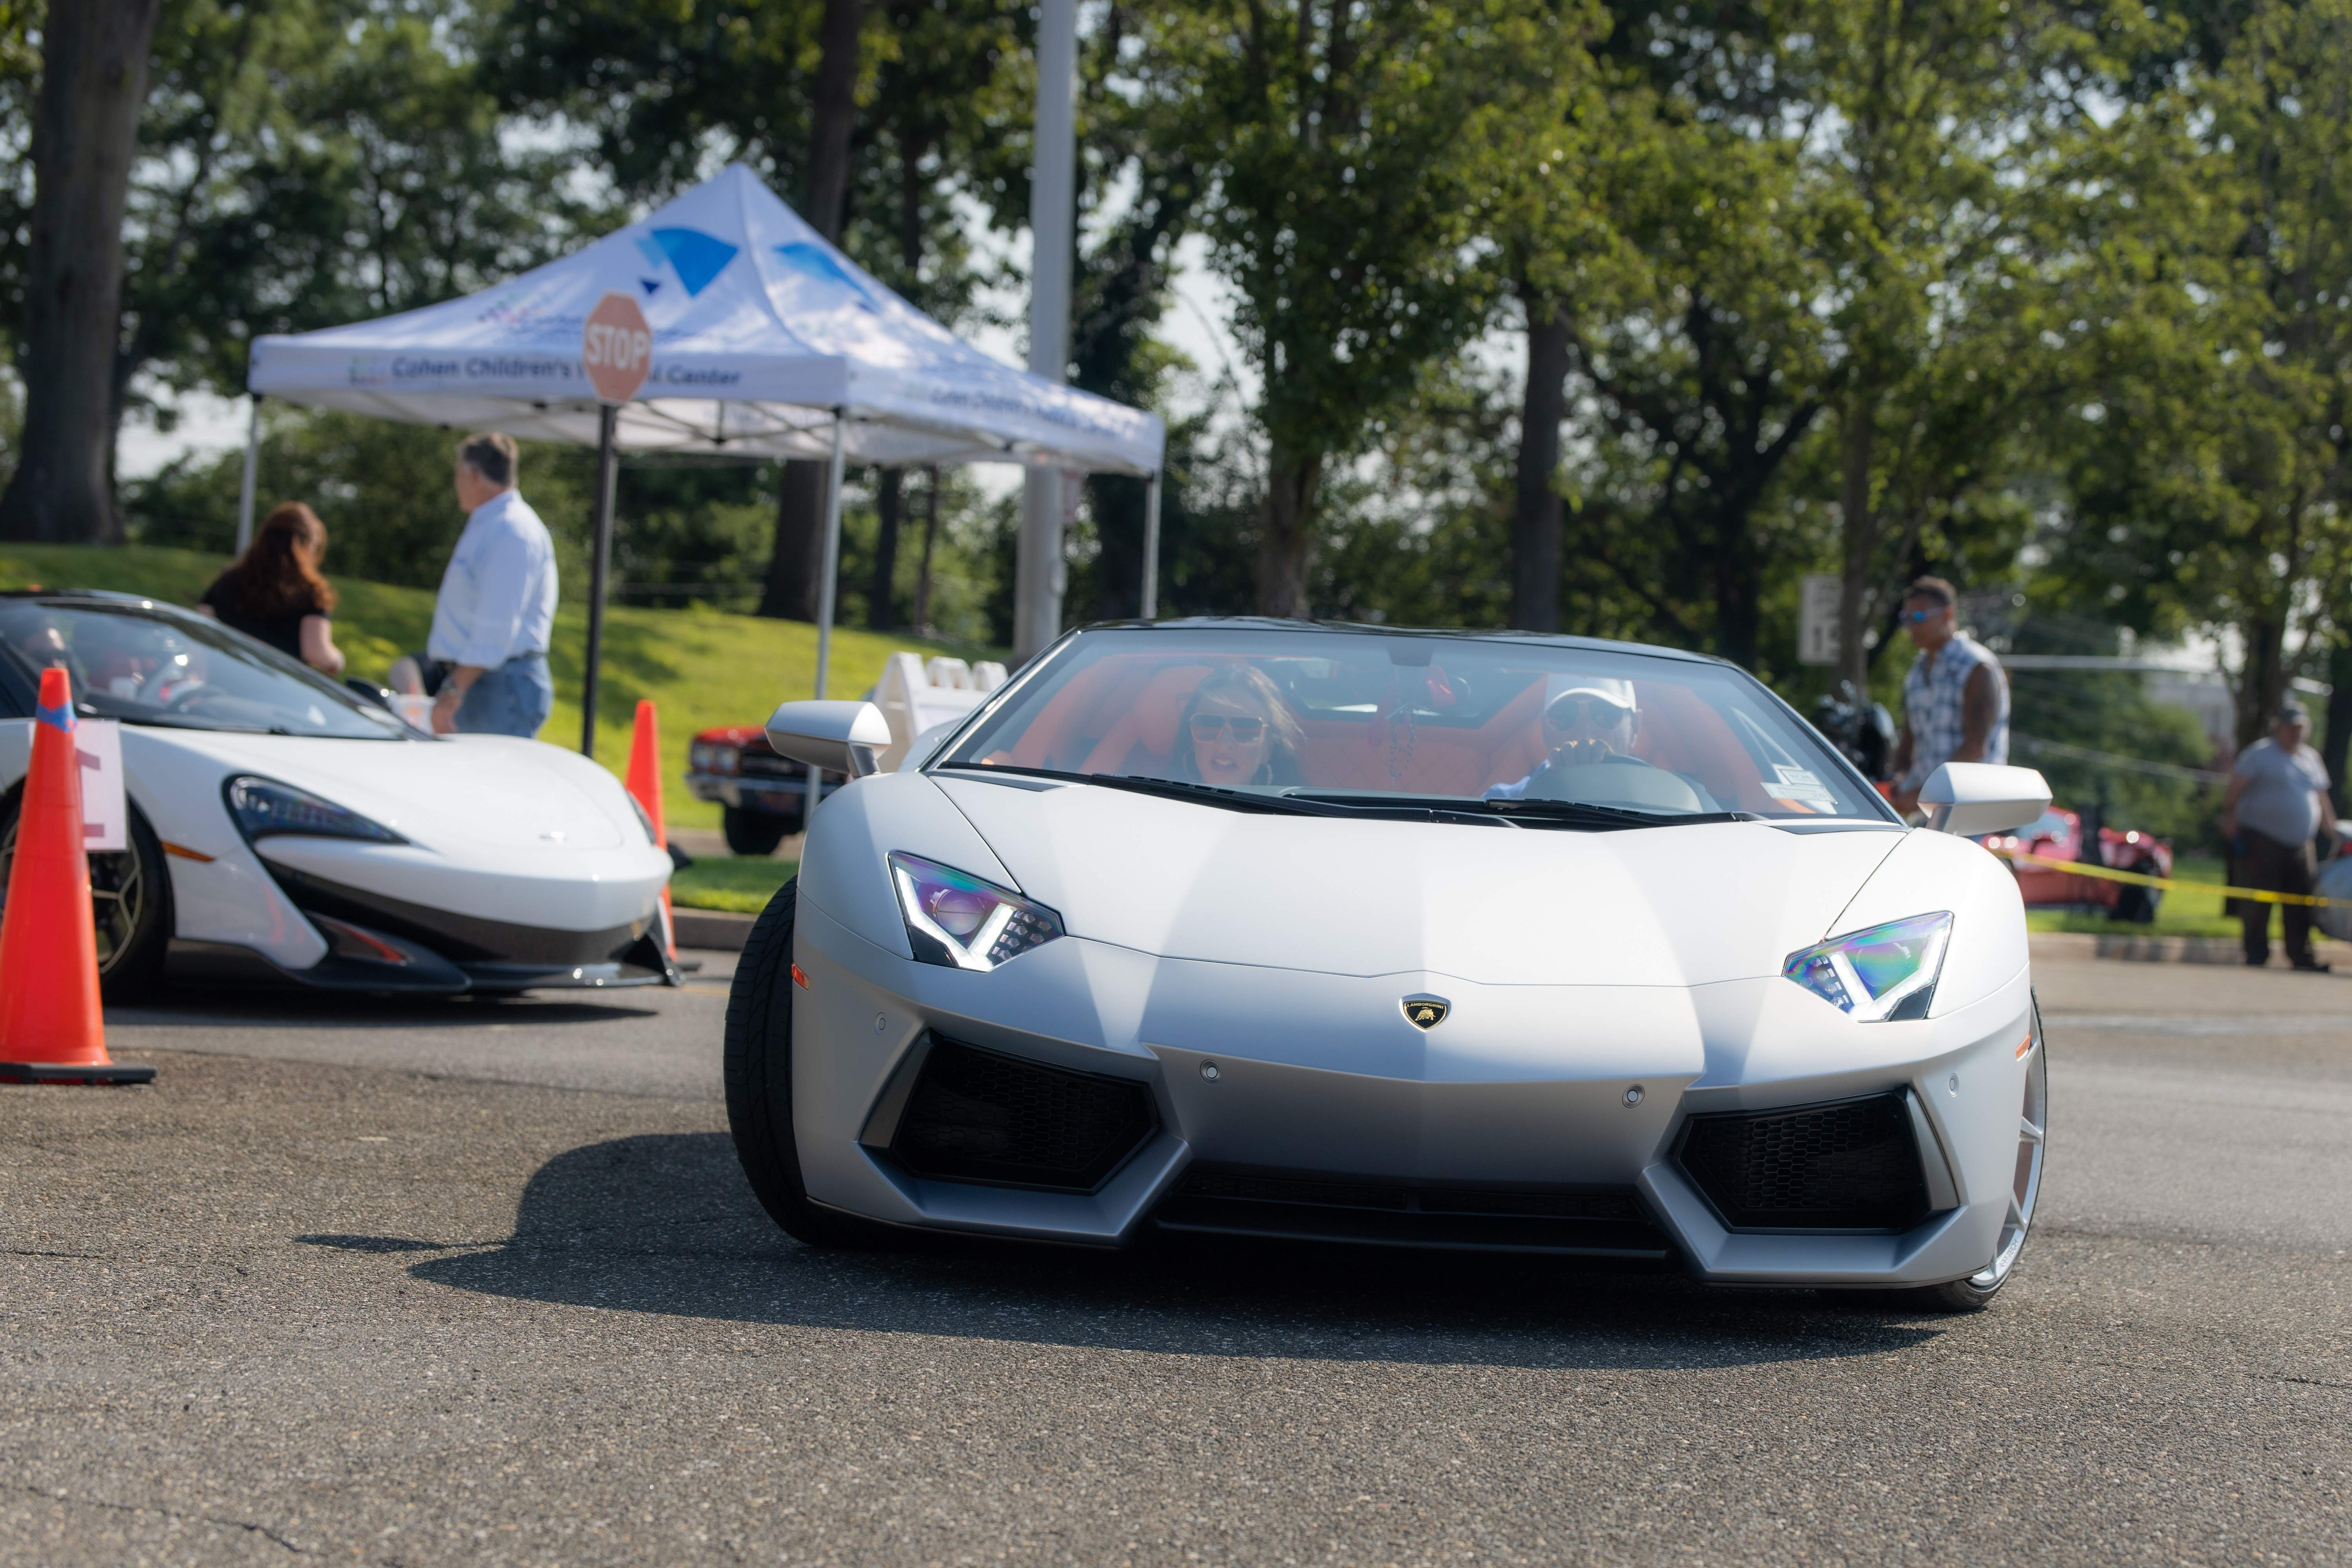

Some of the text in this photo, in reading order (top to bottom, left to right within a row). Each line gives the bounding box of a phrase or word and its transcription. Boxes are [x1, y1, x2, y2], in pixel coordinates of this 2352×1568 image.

[588, 322, 650, 371] STOP
[392, 355, 458, 379] Cohen
[466, 356, 570, 379] Children's
[667, 363, 740, 385] Center
